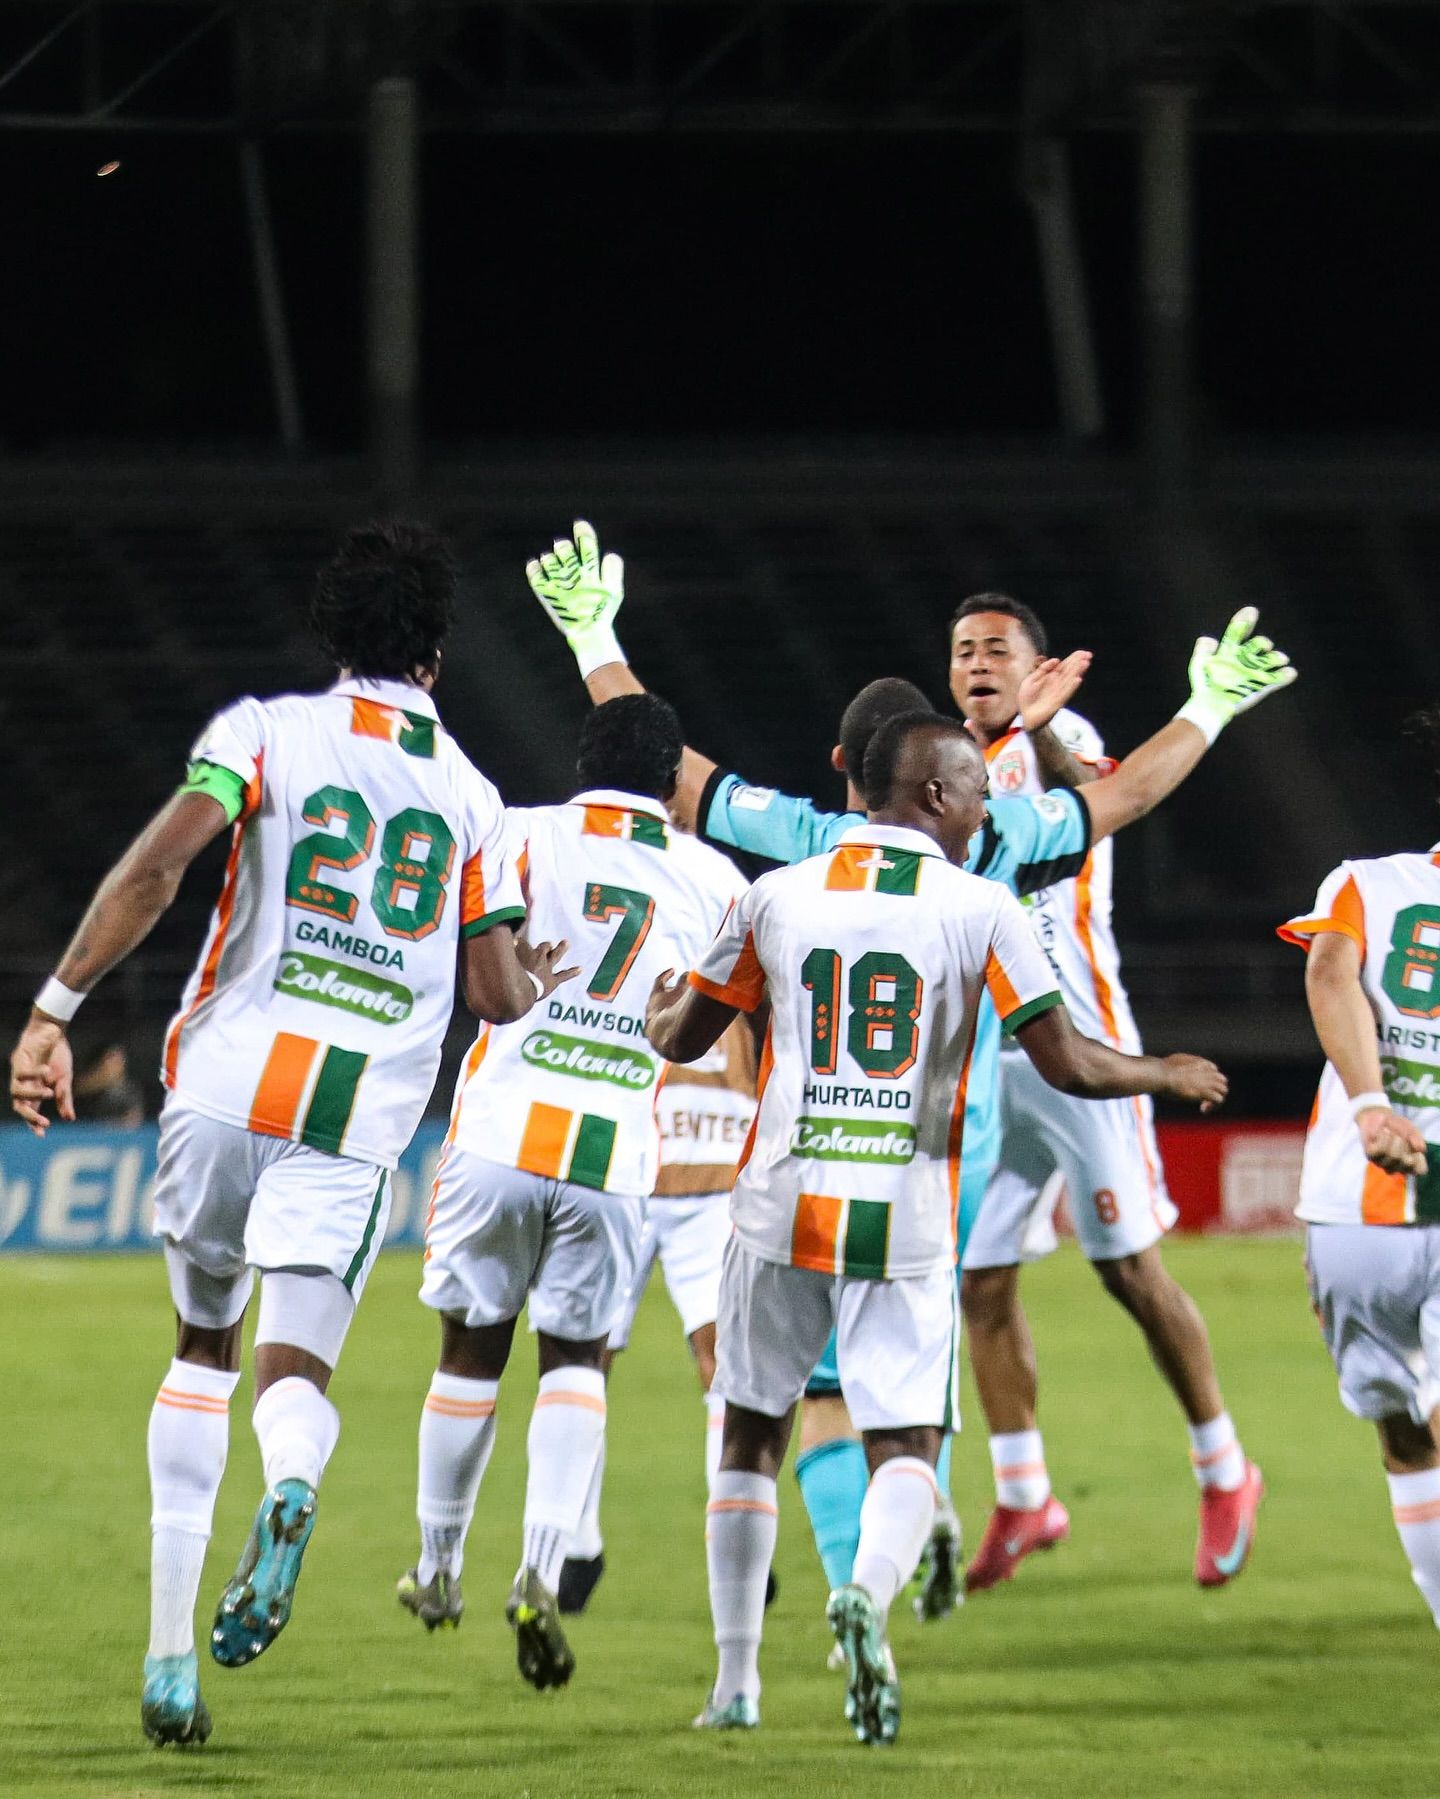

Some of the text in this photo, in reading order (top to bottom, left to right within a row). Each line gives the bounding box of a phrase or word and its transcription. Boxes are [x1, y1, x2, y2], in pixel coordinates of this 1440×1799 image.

[285, 784, 457, 942] 28
[295, 921, 404, 971] GAMBOA
[583, 882, 656, 1002] 7
[279, 957, 409, 1019] Colanta
[548, 1001, 649, 1039] DAWSON
[801, 948, 923, 1079] 18
[523, 1035, 653, 1085] Colanta
[803, 1084, 911, 1110] HURTADO
[793, 1123, 913, 1157] Colanta
